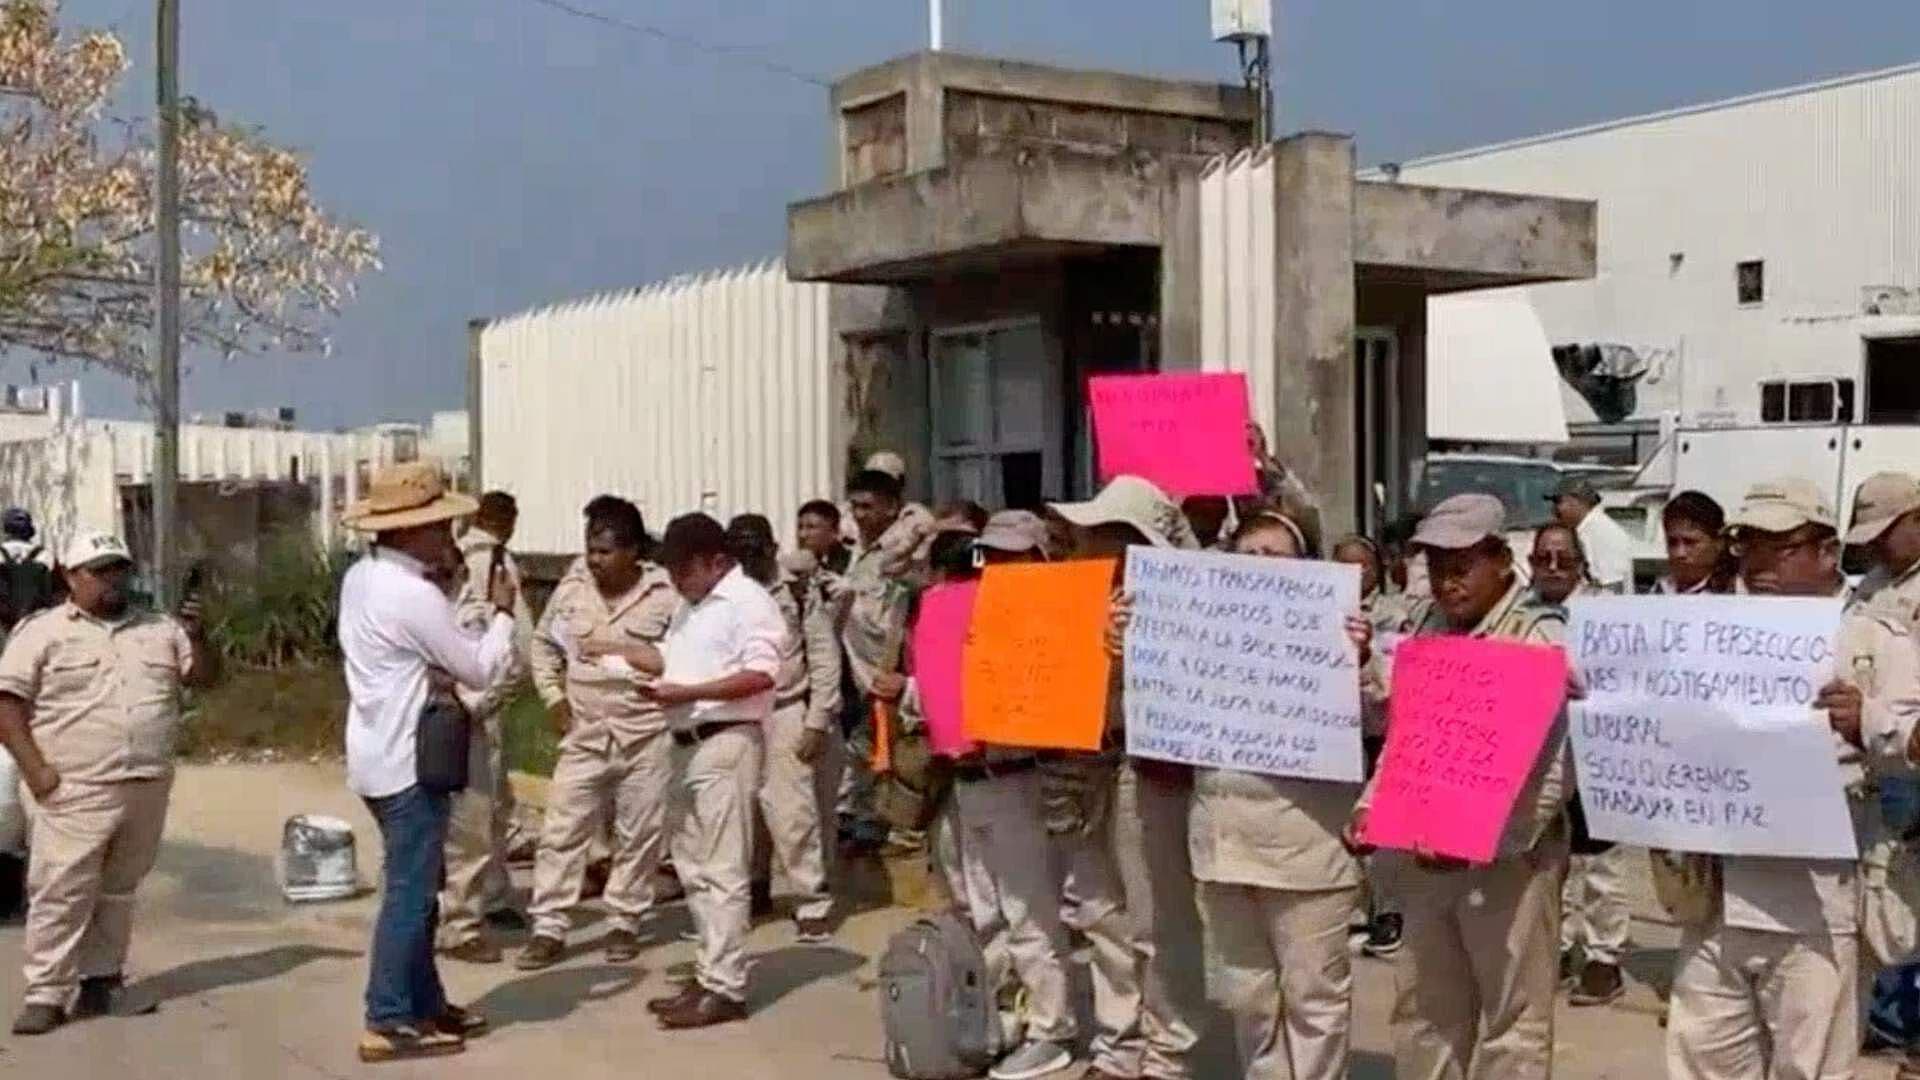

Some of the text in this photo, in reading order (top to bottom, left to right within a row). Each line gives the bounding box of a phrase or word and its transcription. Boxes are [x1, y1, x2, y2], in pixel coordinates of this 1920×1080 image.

[1581, 618, 1649, 658] BASTA
[1660, 617, 1691, 653] DE
[1583, 666, 1619, 694] NES
[1682, 798, 1714, 827] EN
[1723, 800, 1769, 830] PAZ
